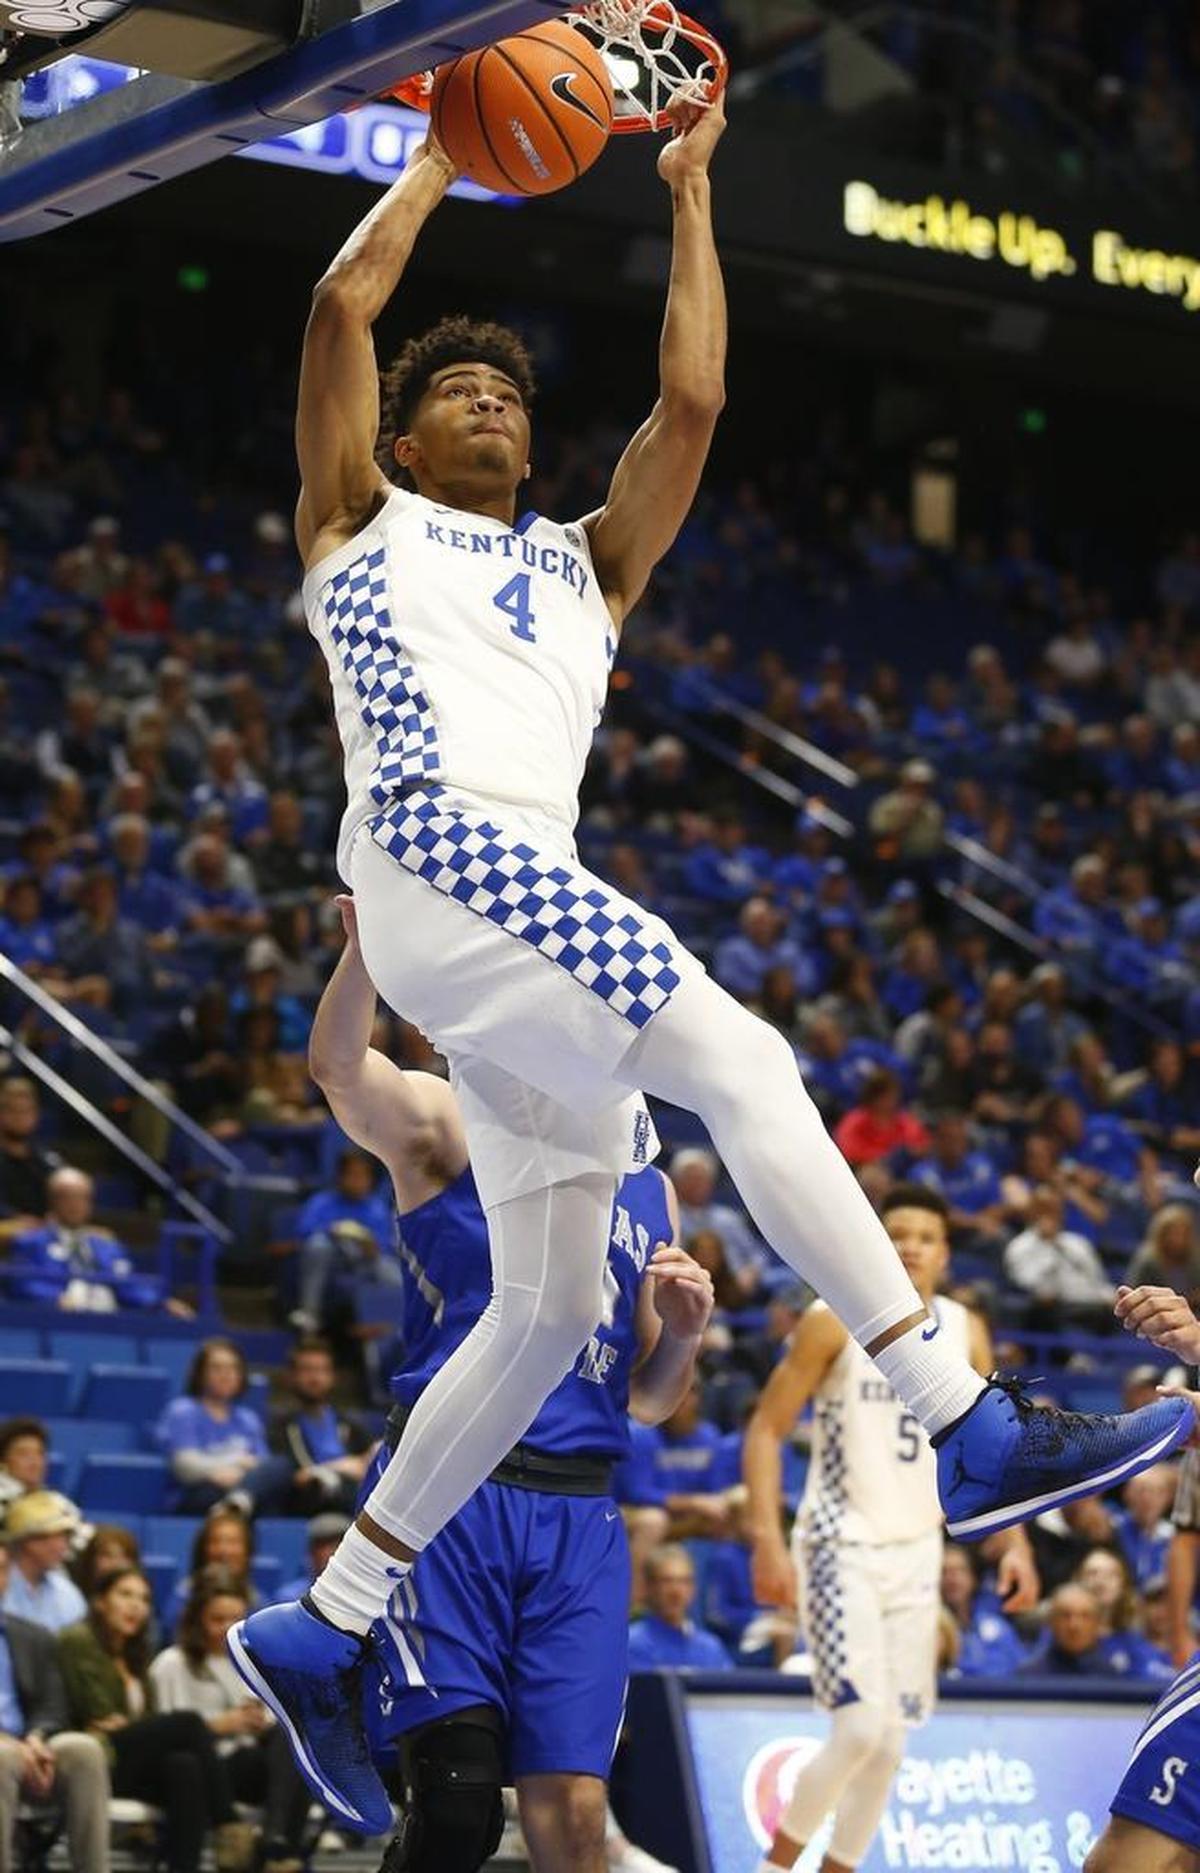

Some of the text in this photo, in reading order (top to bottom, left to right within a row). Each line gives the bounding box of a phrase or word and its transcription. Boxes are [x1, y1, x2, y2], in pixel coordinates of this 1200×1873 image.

[844, 181, 995, 260] Buckle
[999, 212, 1077, 282] Up.
[425, 520, 588, 600] KENTUCKY
[493, 572, 536, 643] 4
[897, 1413, 920, 1463] 5
[896, 1750, 1036, 1815] ayette
[1149, 1756, 1189, 1806] S
